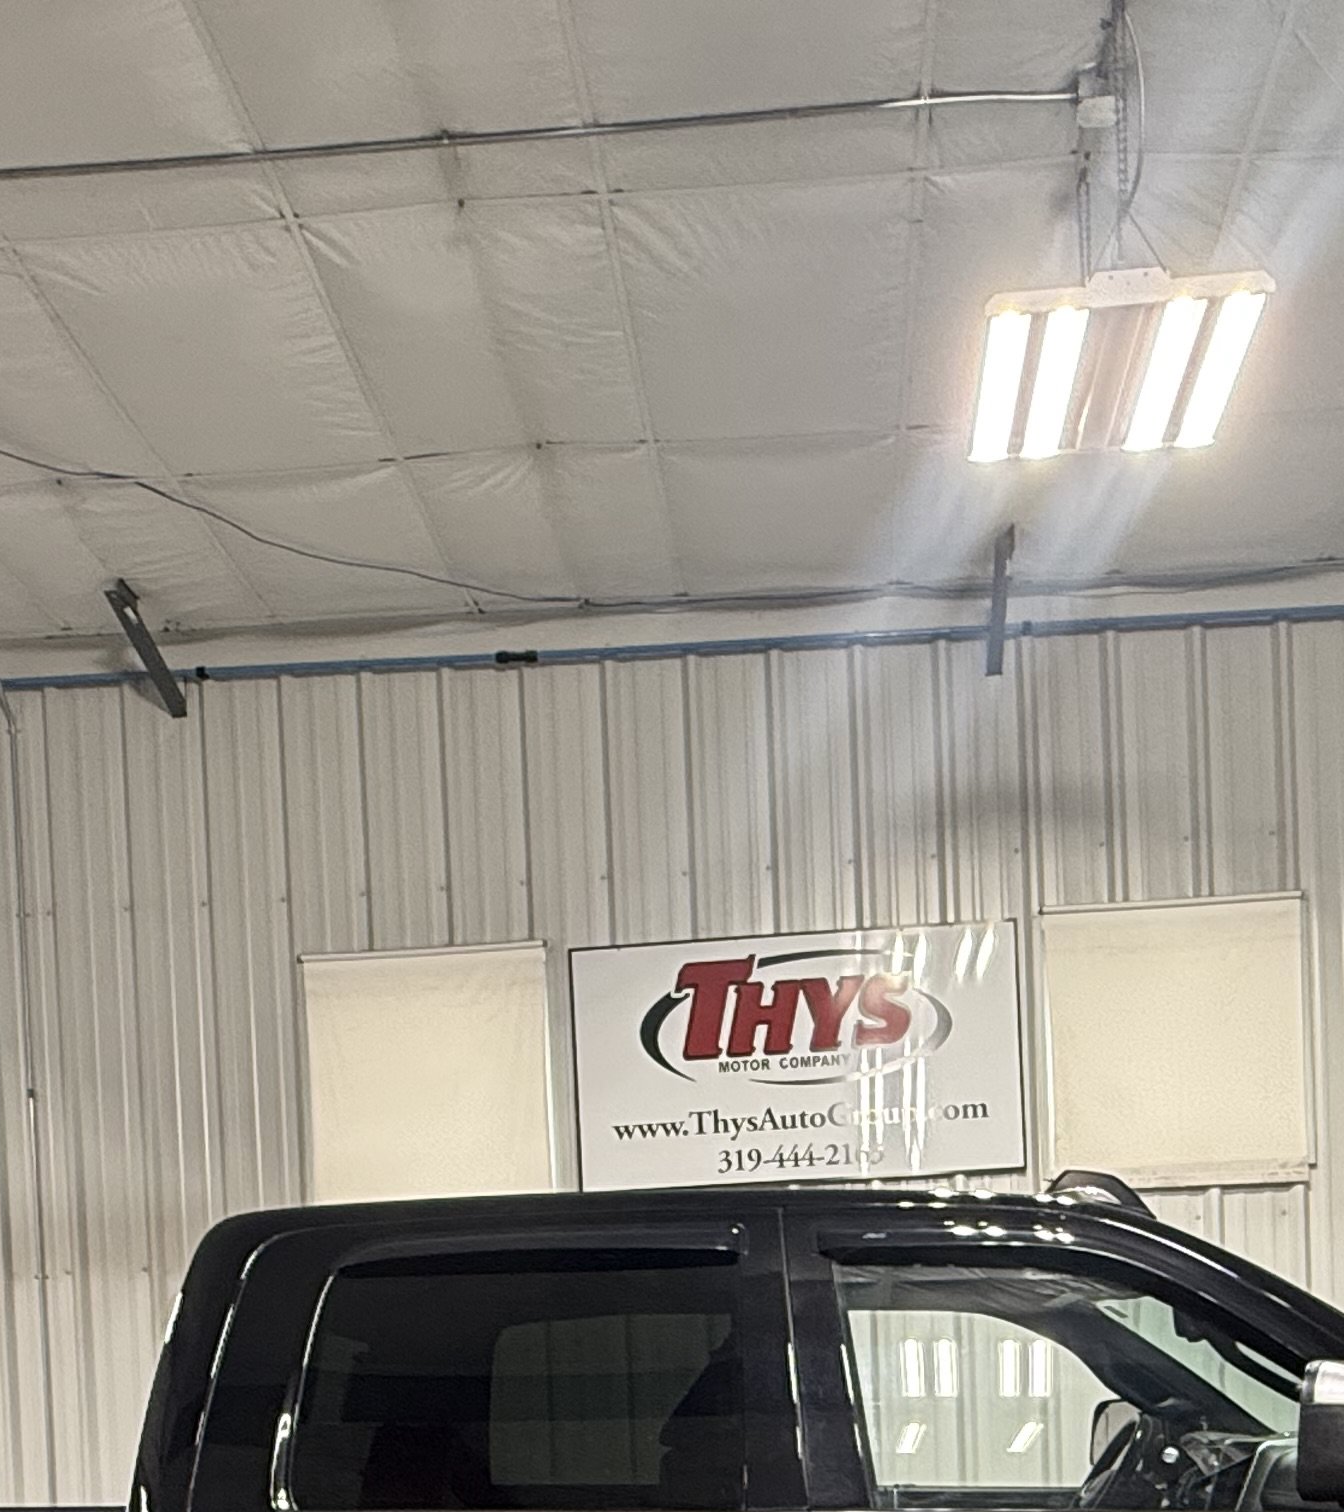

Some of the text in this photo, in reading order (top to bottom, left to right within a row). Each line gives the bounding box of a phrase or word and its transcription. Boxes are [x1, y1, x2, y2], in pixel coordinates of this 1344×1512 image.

[718, 1053, 852, 1073] MOTOR COMPANY
[612, 1101, 989, 1141] www.ThysAutoGroupcom
